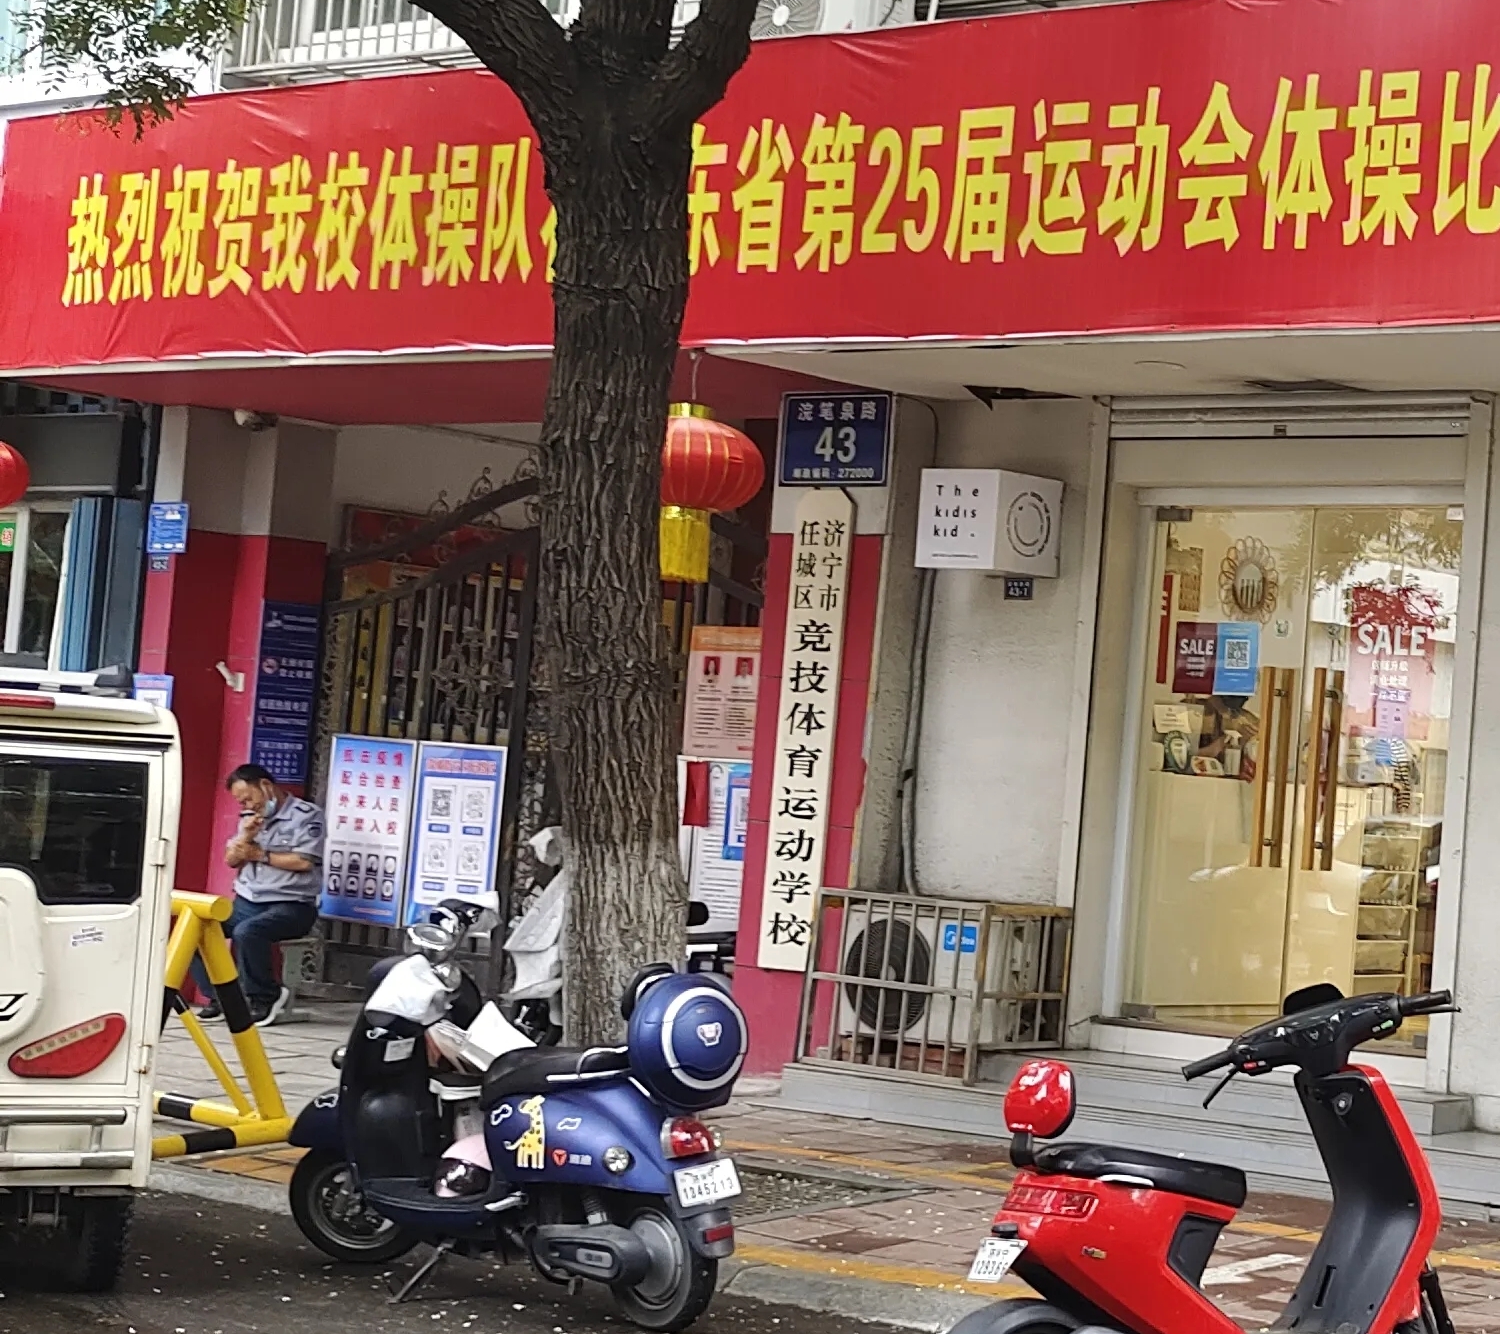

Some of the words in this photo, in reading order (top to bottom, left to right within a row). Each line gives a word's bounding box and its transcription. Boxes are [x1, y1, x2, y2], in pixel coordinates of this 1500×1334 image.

[814, 426, 857, 463] 43
[936, 485, 979, 497] The
[794, 521, 820, 611] 任城区
[817, 519, 846, 613] 济宁市
[1179, 638, 1214, 656] SALE
[1357, 624, 1427, 656] SALE
[767, 619, 833, 946] 竞技体育运动学校
[338, 792, 399, 812] 外来人员
[336, 815, 397, 835] 严禁入校
